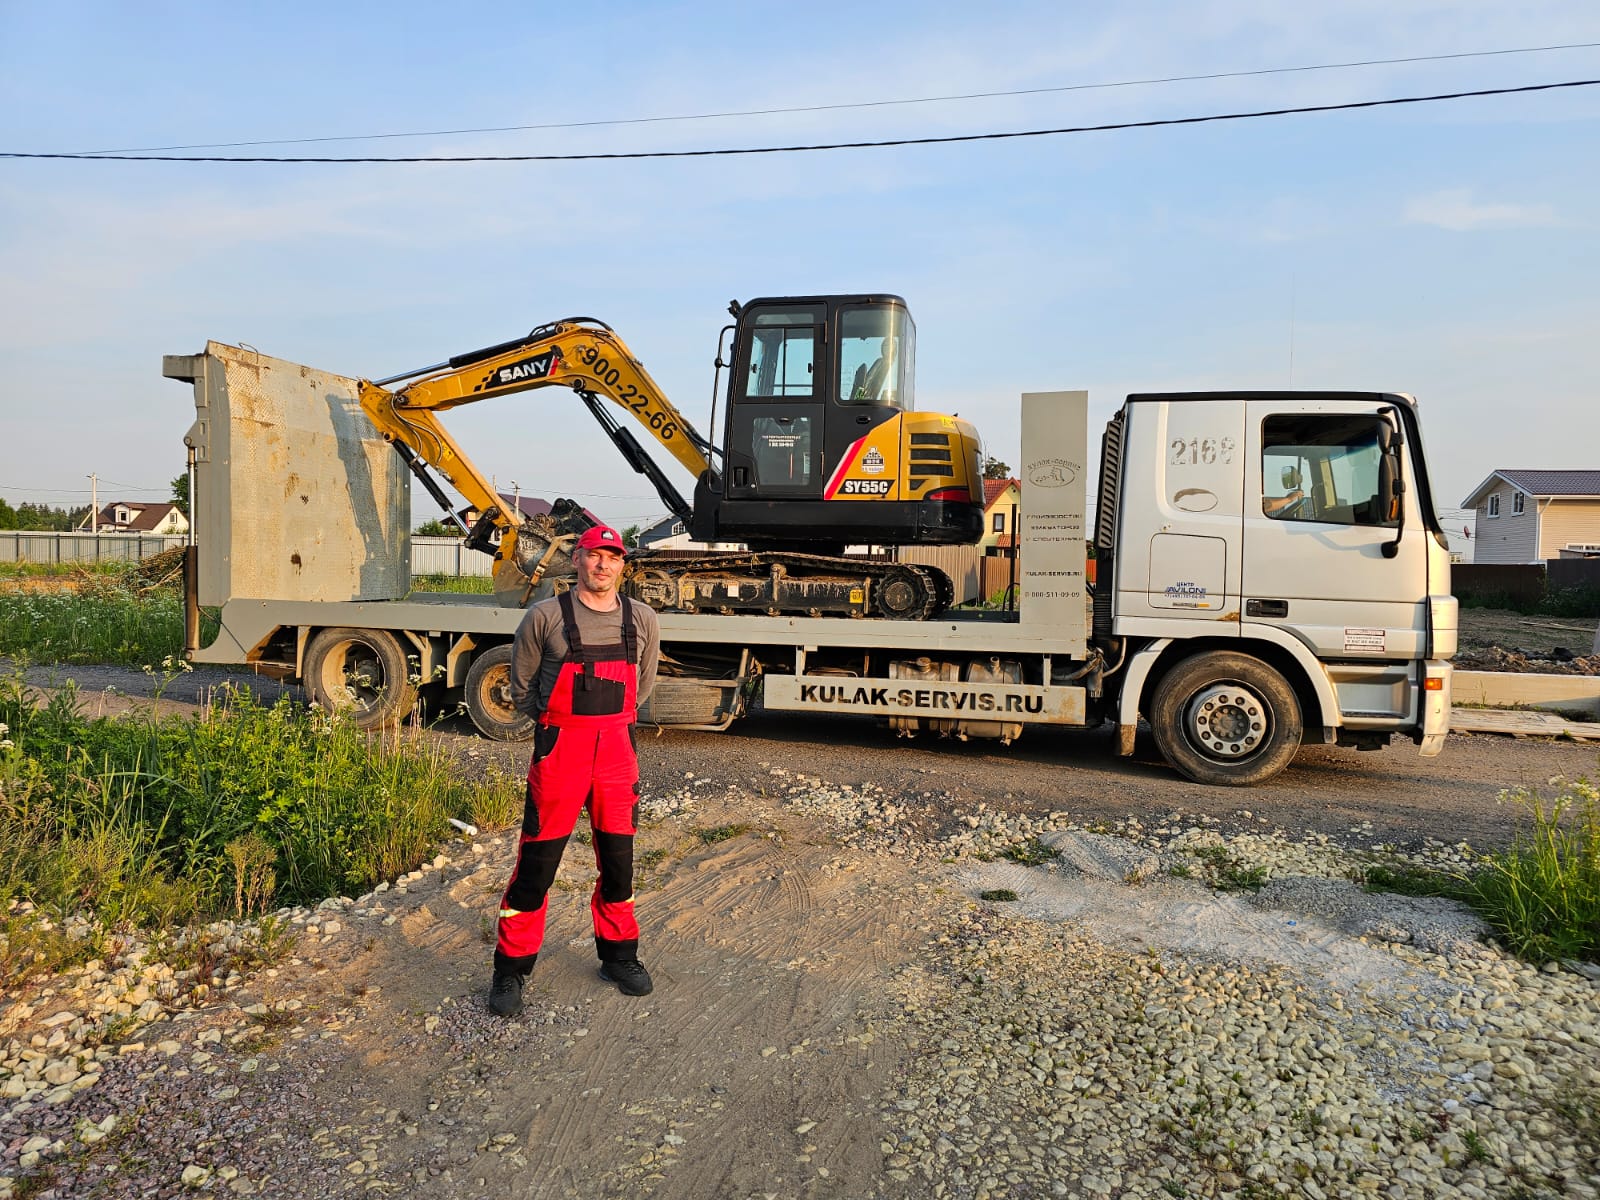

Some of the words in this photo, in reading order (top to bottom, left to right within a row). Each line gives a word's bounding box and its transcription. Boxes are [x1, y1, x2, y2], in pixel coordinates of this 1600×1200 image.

[500, 359, 548, 383] SANY
[582, 349, 677, 440] 900-22-66
[844, 480, 889, 494] SY55C
[800, 684, 1044, 714] KULAK-SERVIS.RU
